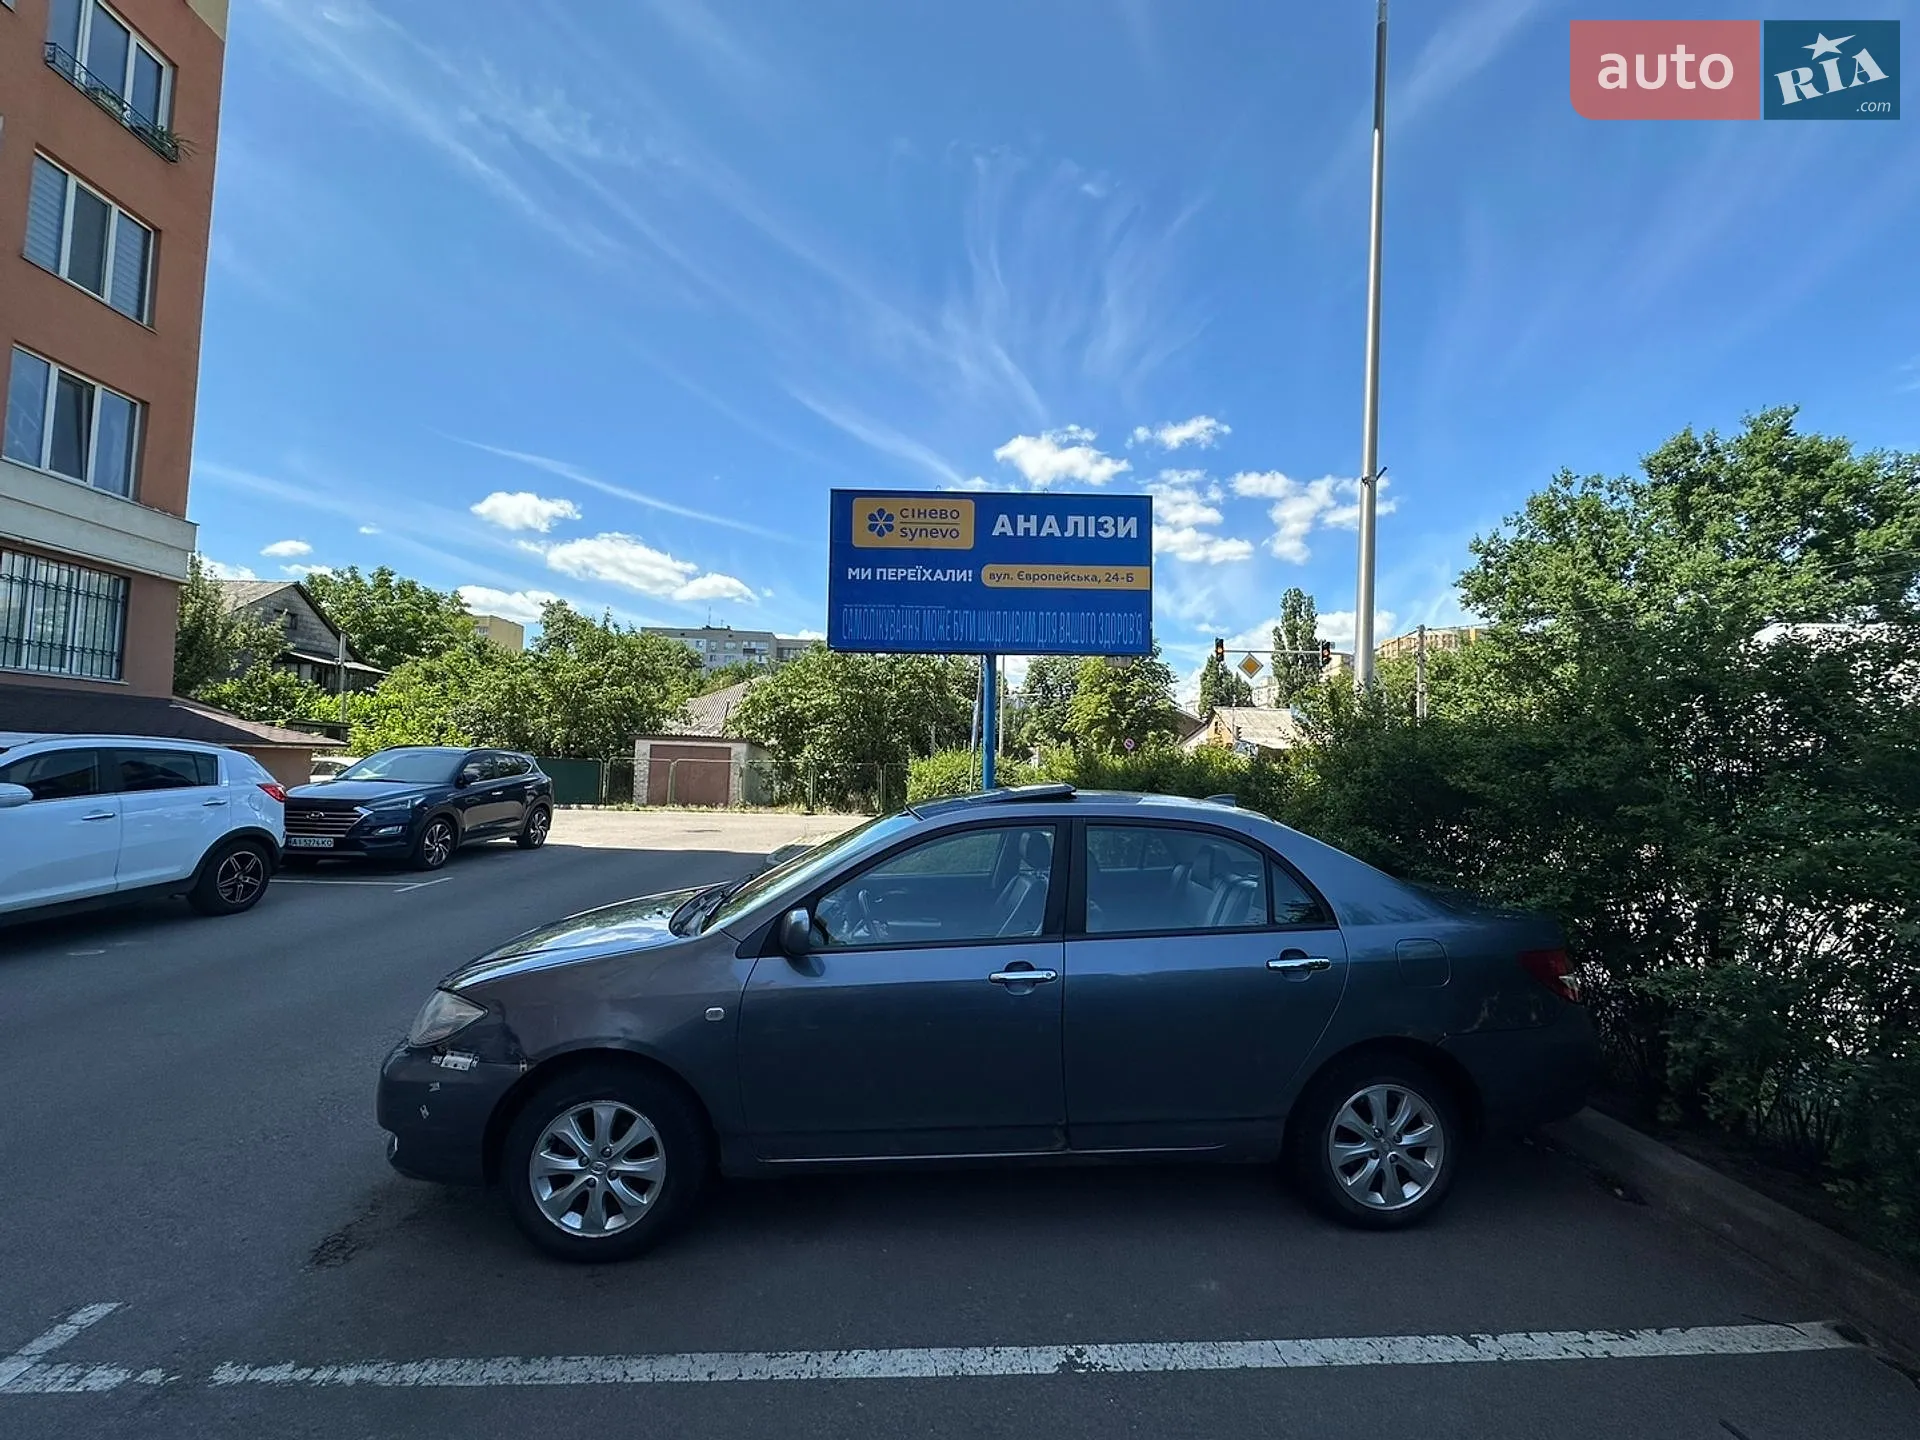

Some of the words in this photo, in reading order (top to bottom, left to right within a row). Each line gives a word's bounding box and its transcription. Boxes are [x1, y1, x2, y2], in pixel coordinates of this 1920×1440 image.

[899, 526, 960, 542] synevo
[991, 514, 1138, 539] АНАЛІЗИ
[847, 567, 872, 580] МИ
[876, 565, 973, 582] ПЕРЕЇХАЛИ!
[989, 571, 1014, 582] вул.
[1017, 571, 1101, 584] Європейська,
[1104, 572, 1135, 583] 24-Б
[922, 609, 951, 642] МОЖЕ
[953, 609, 976, 642] БУТИ
[1037, 611, 1058, 649] ДЛЯ
[1059, 612, 1096, 645] ВАШОГО
